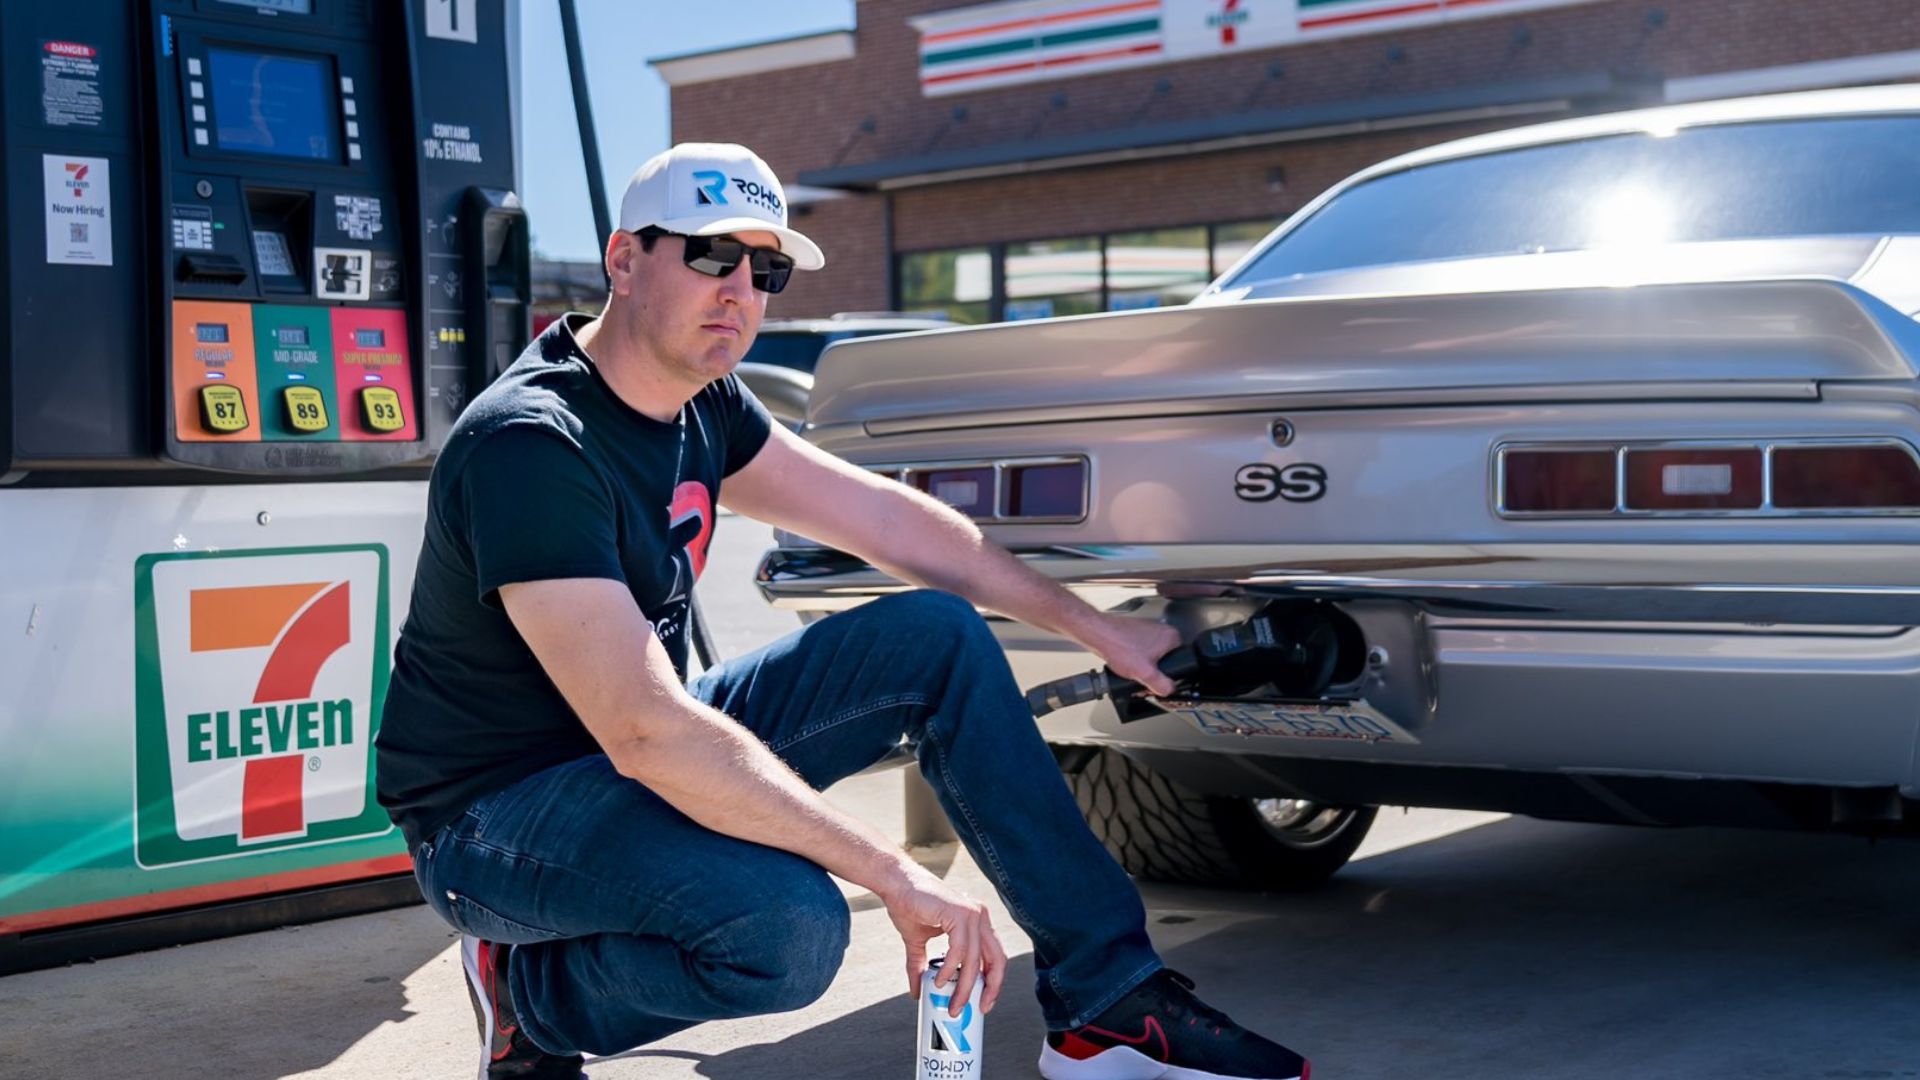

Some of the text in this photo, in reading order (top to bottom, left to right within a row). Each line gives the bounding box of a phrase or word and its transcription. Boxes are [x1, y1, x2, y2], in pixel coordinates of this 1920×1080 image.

[51, 42, 89, 56] DANGER
[433, 123, 471, 141] CONTAINS
[423, 138, 483, 163] 10% ETHANOL
[730, 177, 785, 216] ROWD
[53, 203, 105, 218] Now Hiring
[273, 349, 319, 363] MID-GRADE
[215, 402, 236, 419] 87
[297, 403, 319, 419] 89
[374, 403, 396, 419] 93
[1234, 462, 1328, 504] SS
[190, 580, 350, 840] 7
[922, 1056, 974, 1073] ROWDY
